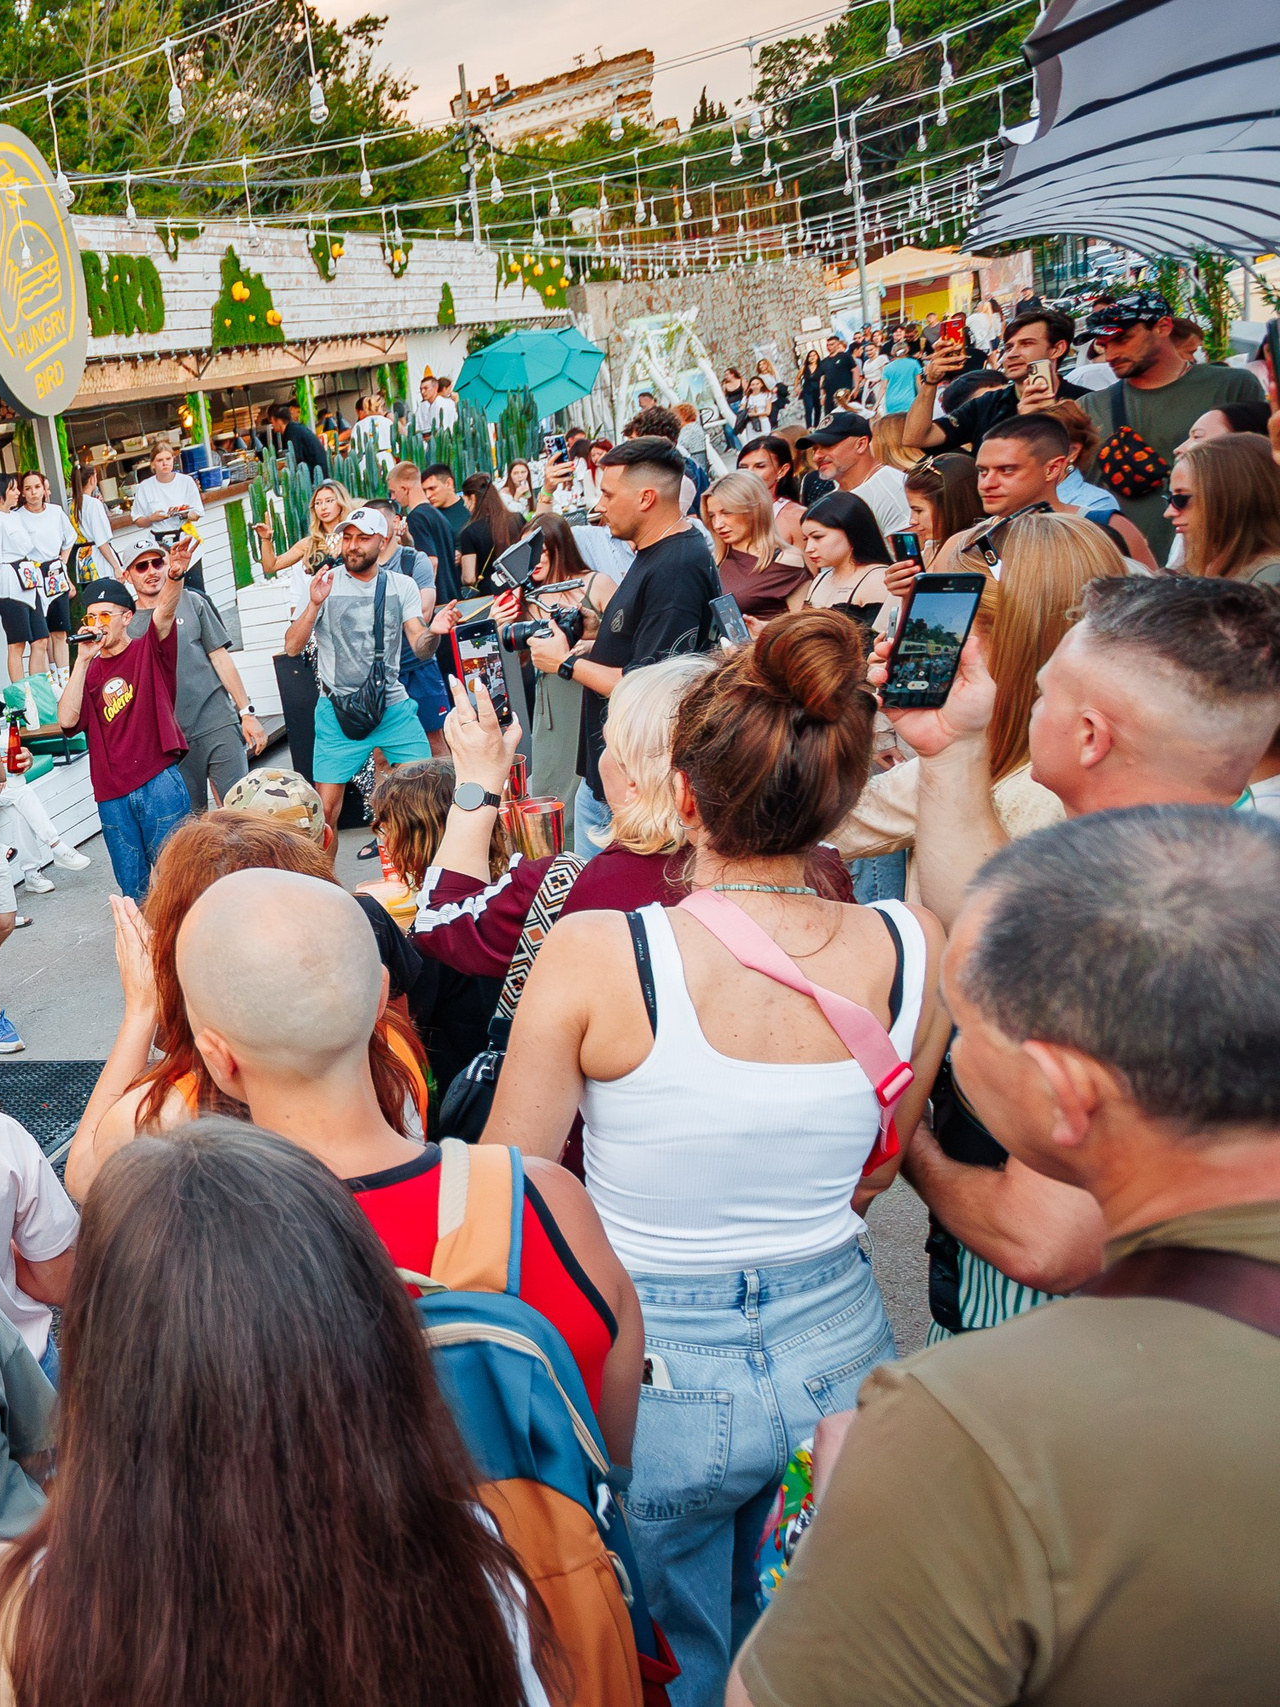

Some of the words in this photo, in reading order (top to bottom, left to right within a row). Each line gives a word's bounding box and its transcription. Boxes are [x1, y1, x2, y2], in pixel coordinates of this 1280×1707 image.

[80, 251, 165, 338] BIRD
[16, 306, 67, 360] HUNGRY
[34, 360, 65, 400] BIRD
